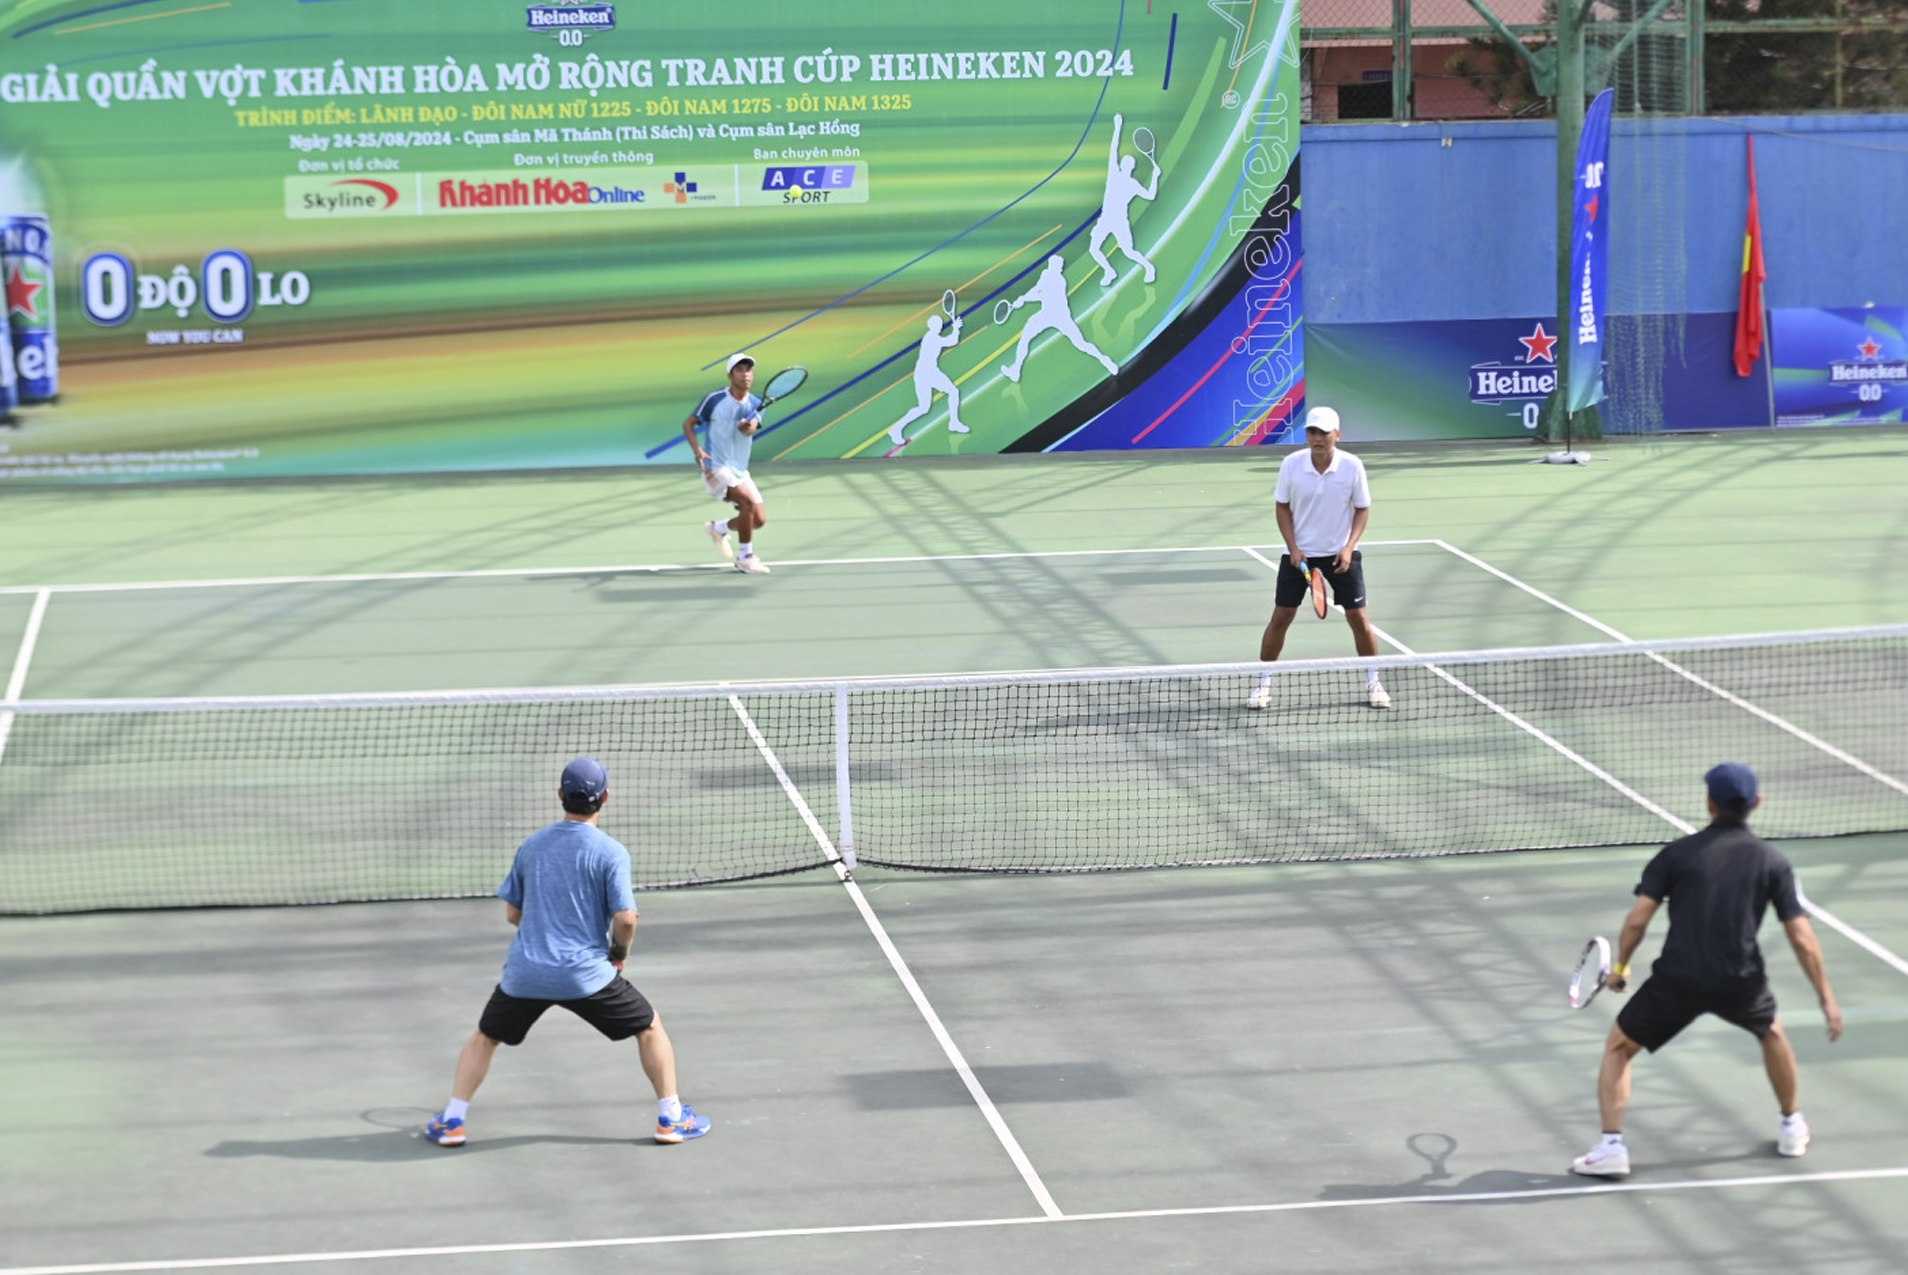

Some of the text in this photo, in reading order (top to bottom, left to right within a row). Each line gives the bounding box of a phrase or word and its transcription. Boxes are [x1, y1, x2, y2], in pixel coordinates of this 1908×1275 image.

[530, 9, 609, 25] Heineken
[1, 47, 1133, 108] GIẢI QUẦN VỢT KHÁNH HÒA MỞ RỘNG TRANH CÚP HEINEKEN 2024
[235, 105, 298, 127] TRÌNH
[360, 103, 415, 124] LÃNH
[419, 106, 458, 126] ĐẠO
[472, 101, 506, 121] ĐÔI
[511, 103, 554, 120] NAM
[559, 99, 588, 119] NỮ
[590, 101, 632, 118] 1225
[646, 96, 679, 116] ĐÔI
[685, 99, 727, 115] NAM
[731, 97, 772, 114] 1275
[786, 93, 819, 112] ĐÔI
[824, 95, 867, 112] NAM
[871, 94, 912, 110] 1325
[289, 133, 330, 152] Ngày
[463, 130, 499, 148] Cụm
[503, 128, 531, 143] sân
[534, 128, 560, 143] Mã
[561, 126, 613, 142] Thánh
[616, 125, 648, 143] (Thi
[650, 124, 694, 142] Sách)
[697, 123, 716, 139] và
[719, 124, 754, 141] Cụm
[757, 122, 785, 137] sân
[788, 122, 815, 139] Lạc
[819, 118, 860, 138] Hồng
[514, 153, 543, 166] Đơn
[546, 152, 559, 167] vị
[612, 150, 654, 165] thông
[753, 146, 860, 160] Ban chuyên môn
[303, 192, 376, 211] Skyline
[588, 185, 645, 204] Online
[138, 265, 198, 318] ĐỘ
[257, 271, 310, 306] LO
[1831, 364, 1907, 381] Heineken
[1477, 370, 1557, 395] Heine
